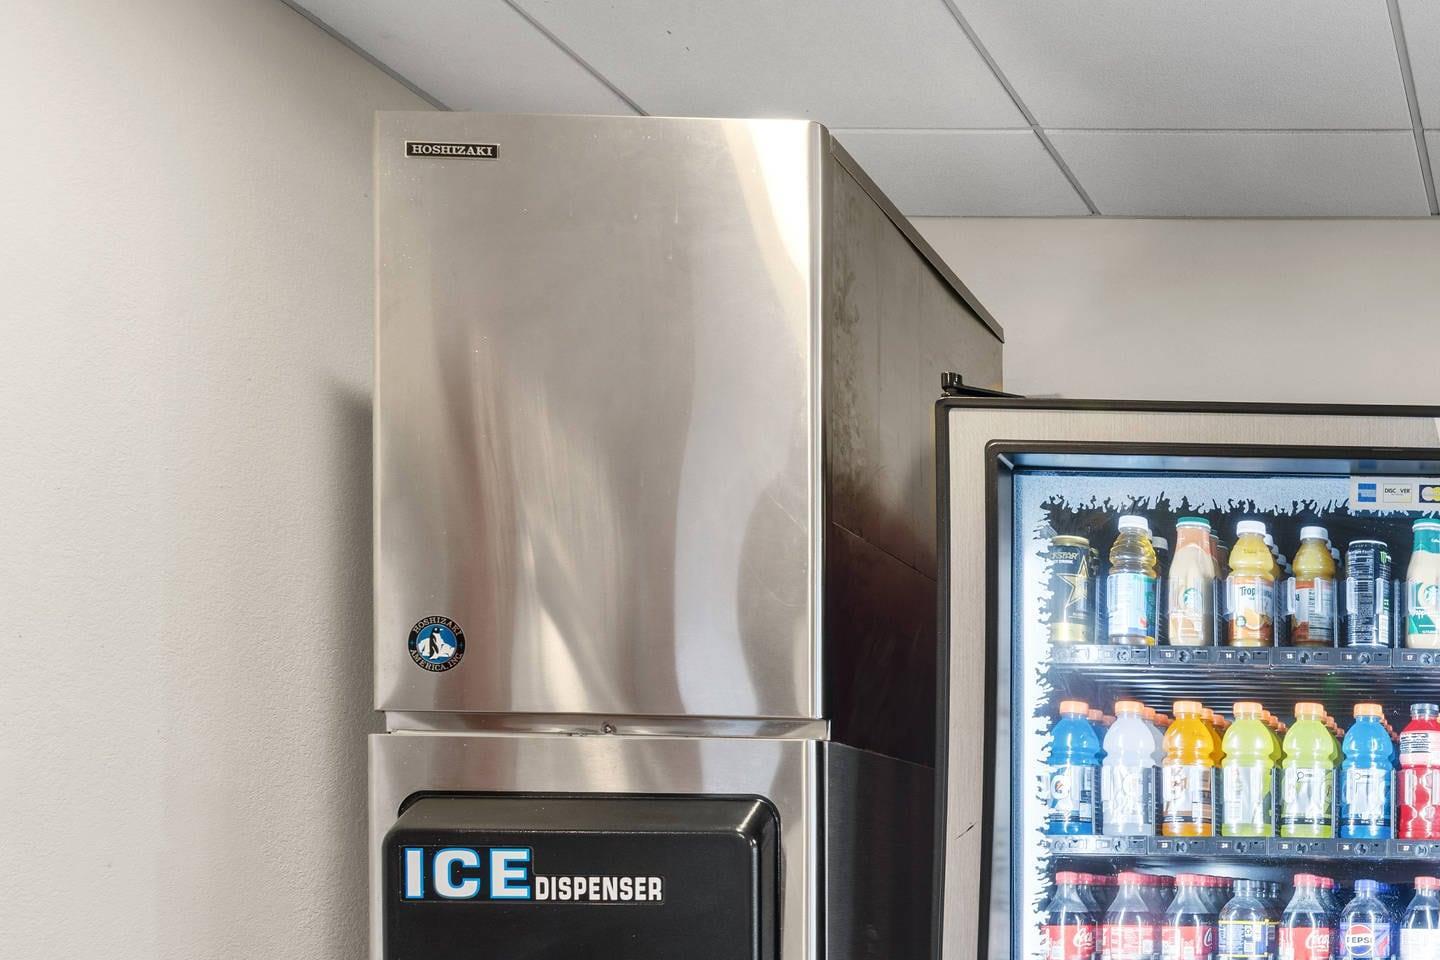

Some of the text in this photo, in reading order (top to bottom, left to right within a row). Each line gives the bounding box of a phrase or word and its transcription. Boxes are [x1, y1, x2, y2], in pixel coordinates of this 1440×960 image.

[411, 144, 492, 156] HOSHIZAKI
[413, 617, 462, 635] HOSHIZAKI
[404, 847, 663, 901] ICE DISPENSER
